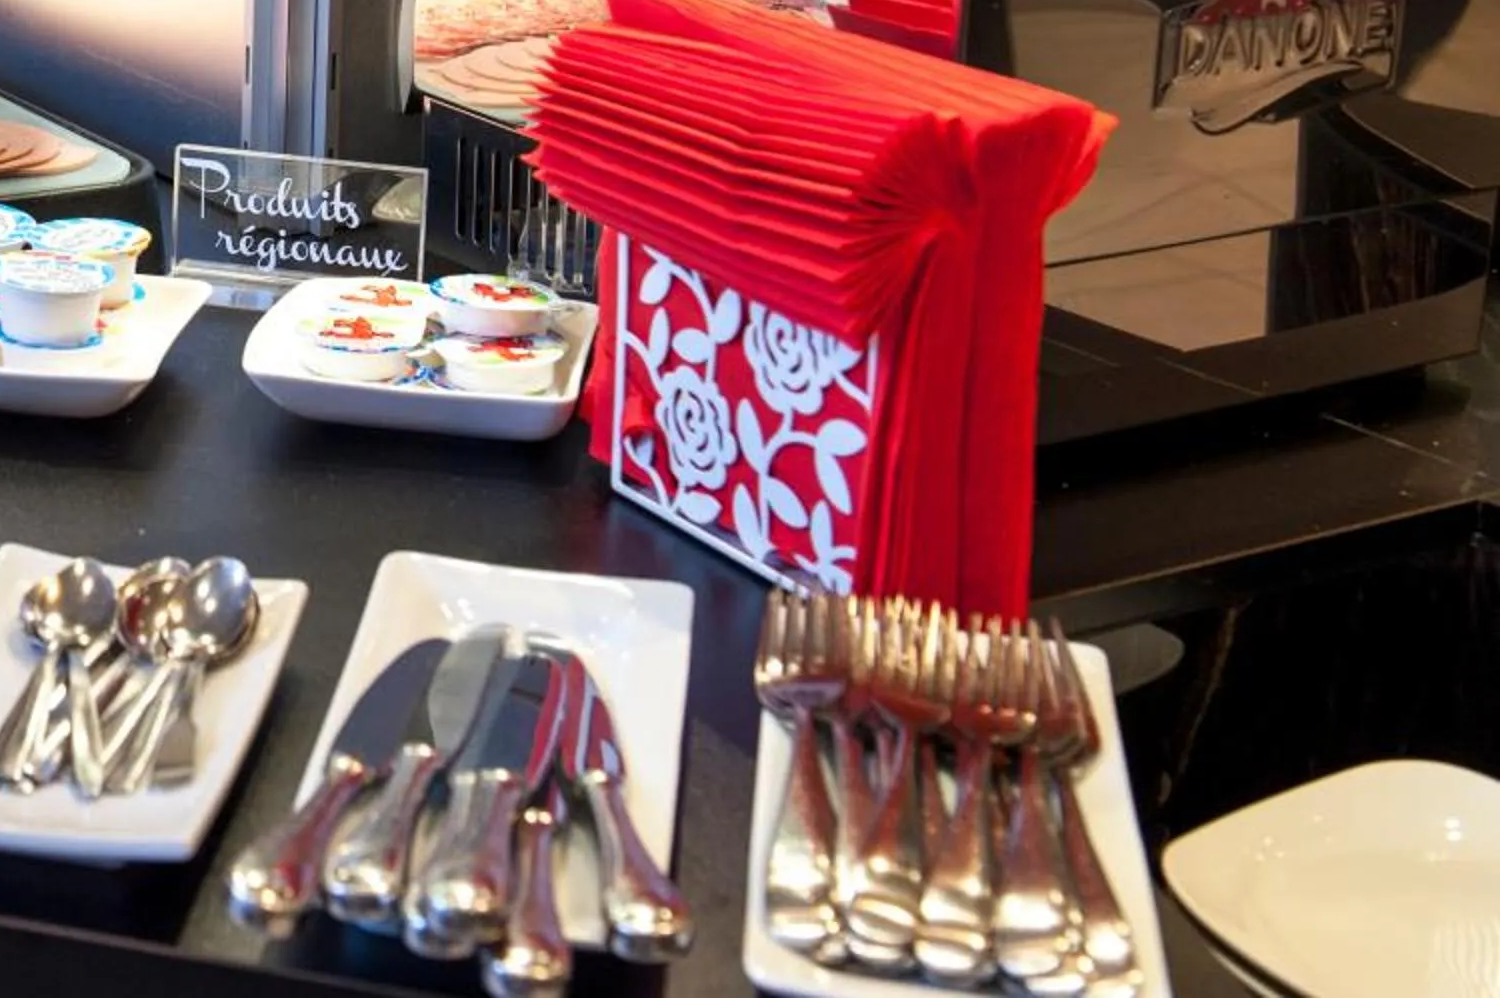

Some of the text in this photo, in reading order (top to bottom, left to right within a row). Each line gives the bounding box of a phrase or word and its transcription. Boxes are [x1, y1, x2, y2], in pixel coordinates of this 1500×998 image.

[1179, 0, 1391, 76] DANONE
[180, 157, 361, 229] Produits
[214, 225, 409, 278] régionaux
